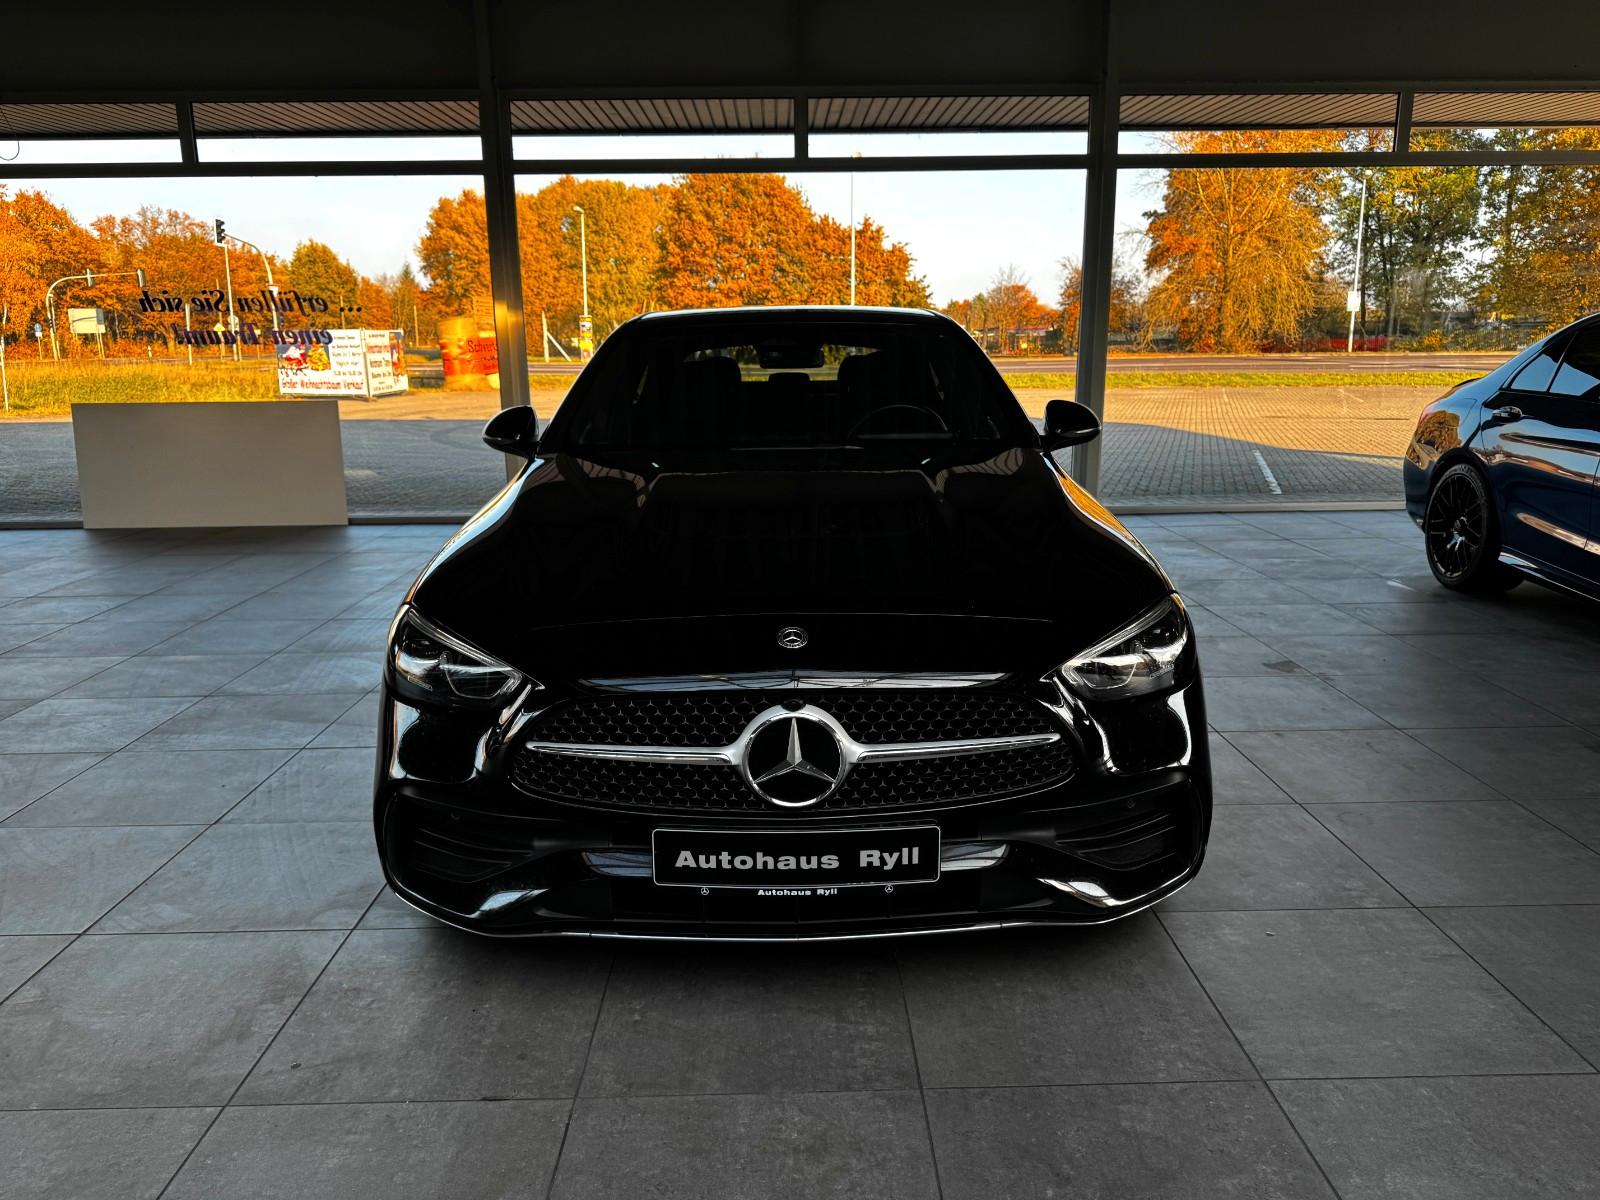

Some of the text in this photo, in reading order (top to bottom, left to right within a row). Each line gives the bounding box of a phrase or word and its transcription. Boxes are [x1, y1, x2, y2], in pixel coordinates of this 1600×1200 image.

[675, 847, 920, 871] Autohaus Ryll
[816, 888, 838, 896] Ryll
